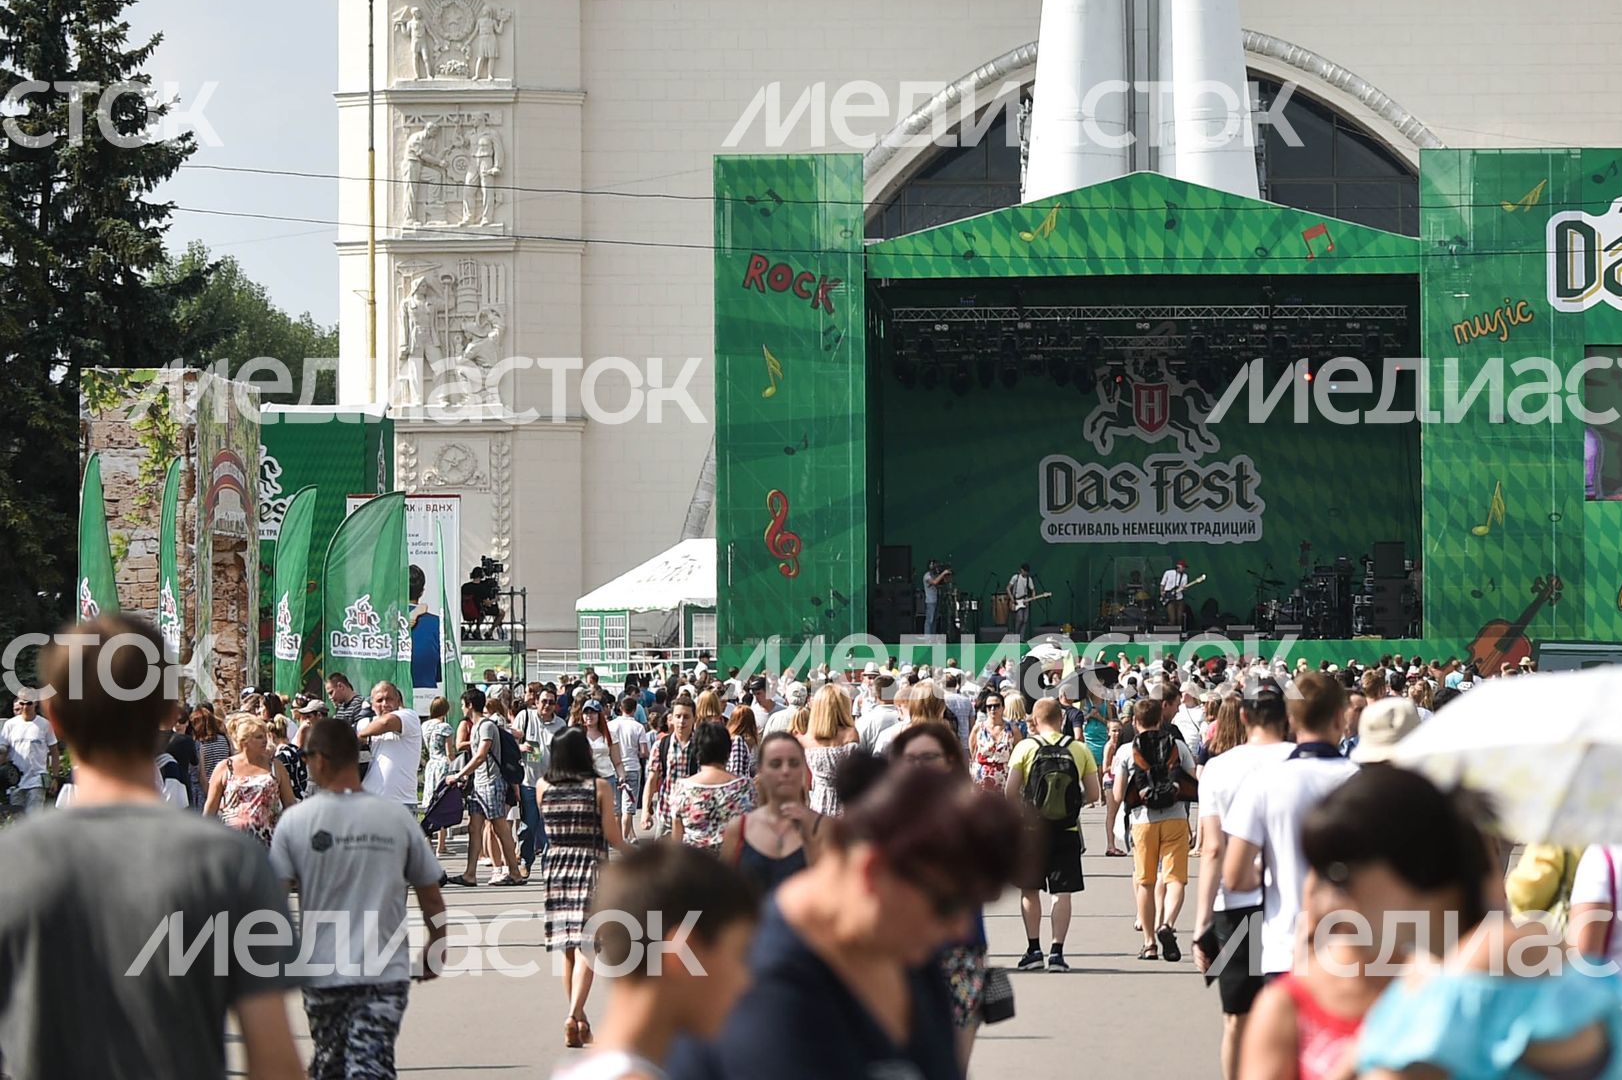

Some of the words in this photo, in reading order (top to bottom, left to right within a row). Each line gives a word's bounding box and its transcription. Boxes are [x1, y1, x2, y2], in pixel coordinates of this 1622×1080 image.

[742, 252, 842, 315] ROCK
[1453, 297, 1535, 347] music
[1046, 461, 1140, 515] Das
[1150, 460, 1258, 516] Fest
[425, 503, 453, 513] ВДНХ
[1047, 521, 1120, 536] ФЕСТИВАЛЬ
[1122, 522, 1188, 538] НЕМЕЦКИХ
[1190, 520, 1257, 538] ТРАДИЦИЙ
[332, 632, 358, 648] Das
[362, 633, 390, 649] Fest
